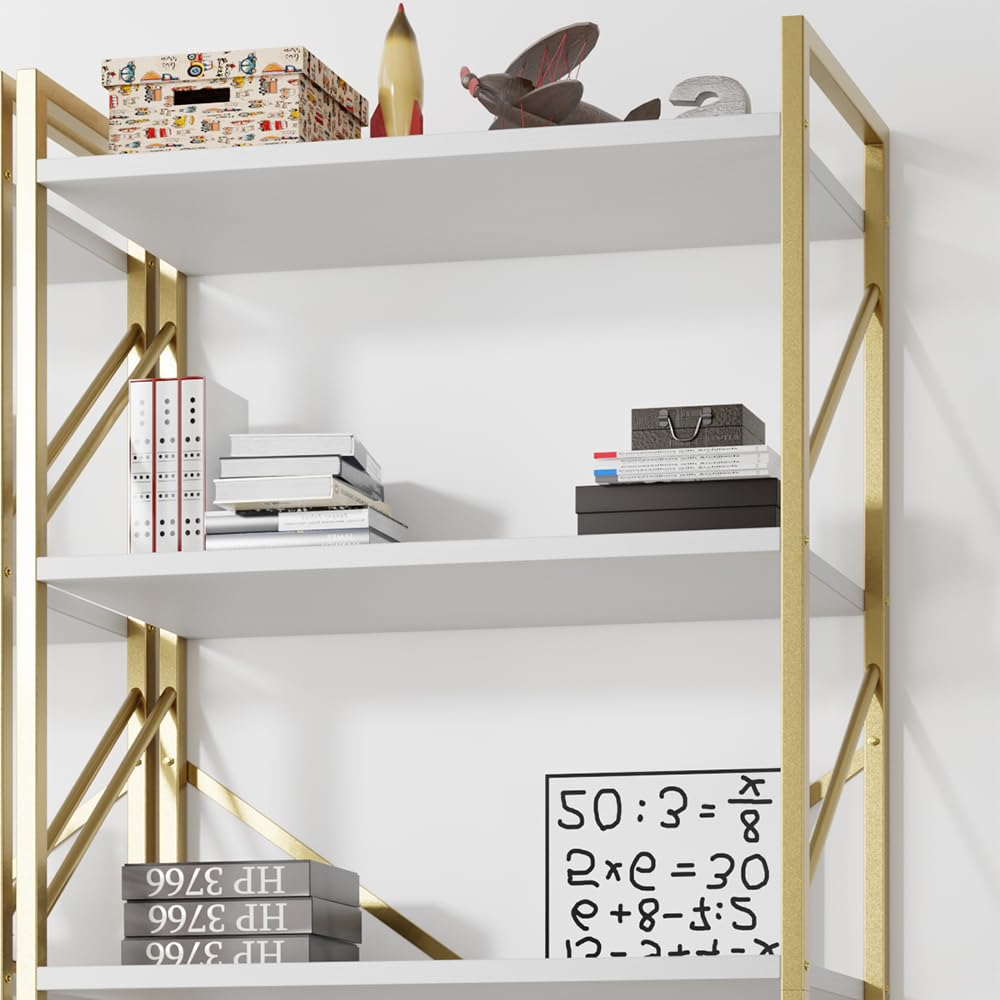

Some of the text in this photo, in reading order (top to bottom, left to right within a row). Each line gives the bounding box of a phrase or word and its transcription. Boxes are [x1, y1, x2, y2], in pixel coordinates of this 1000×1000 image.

[146, 865, 285, 897] HP 3766
[148, 903, 288, 934] HP 3766
[146, 940, 285, 965] HP 3766
